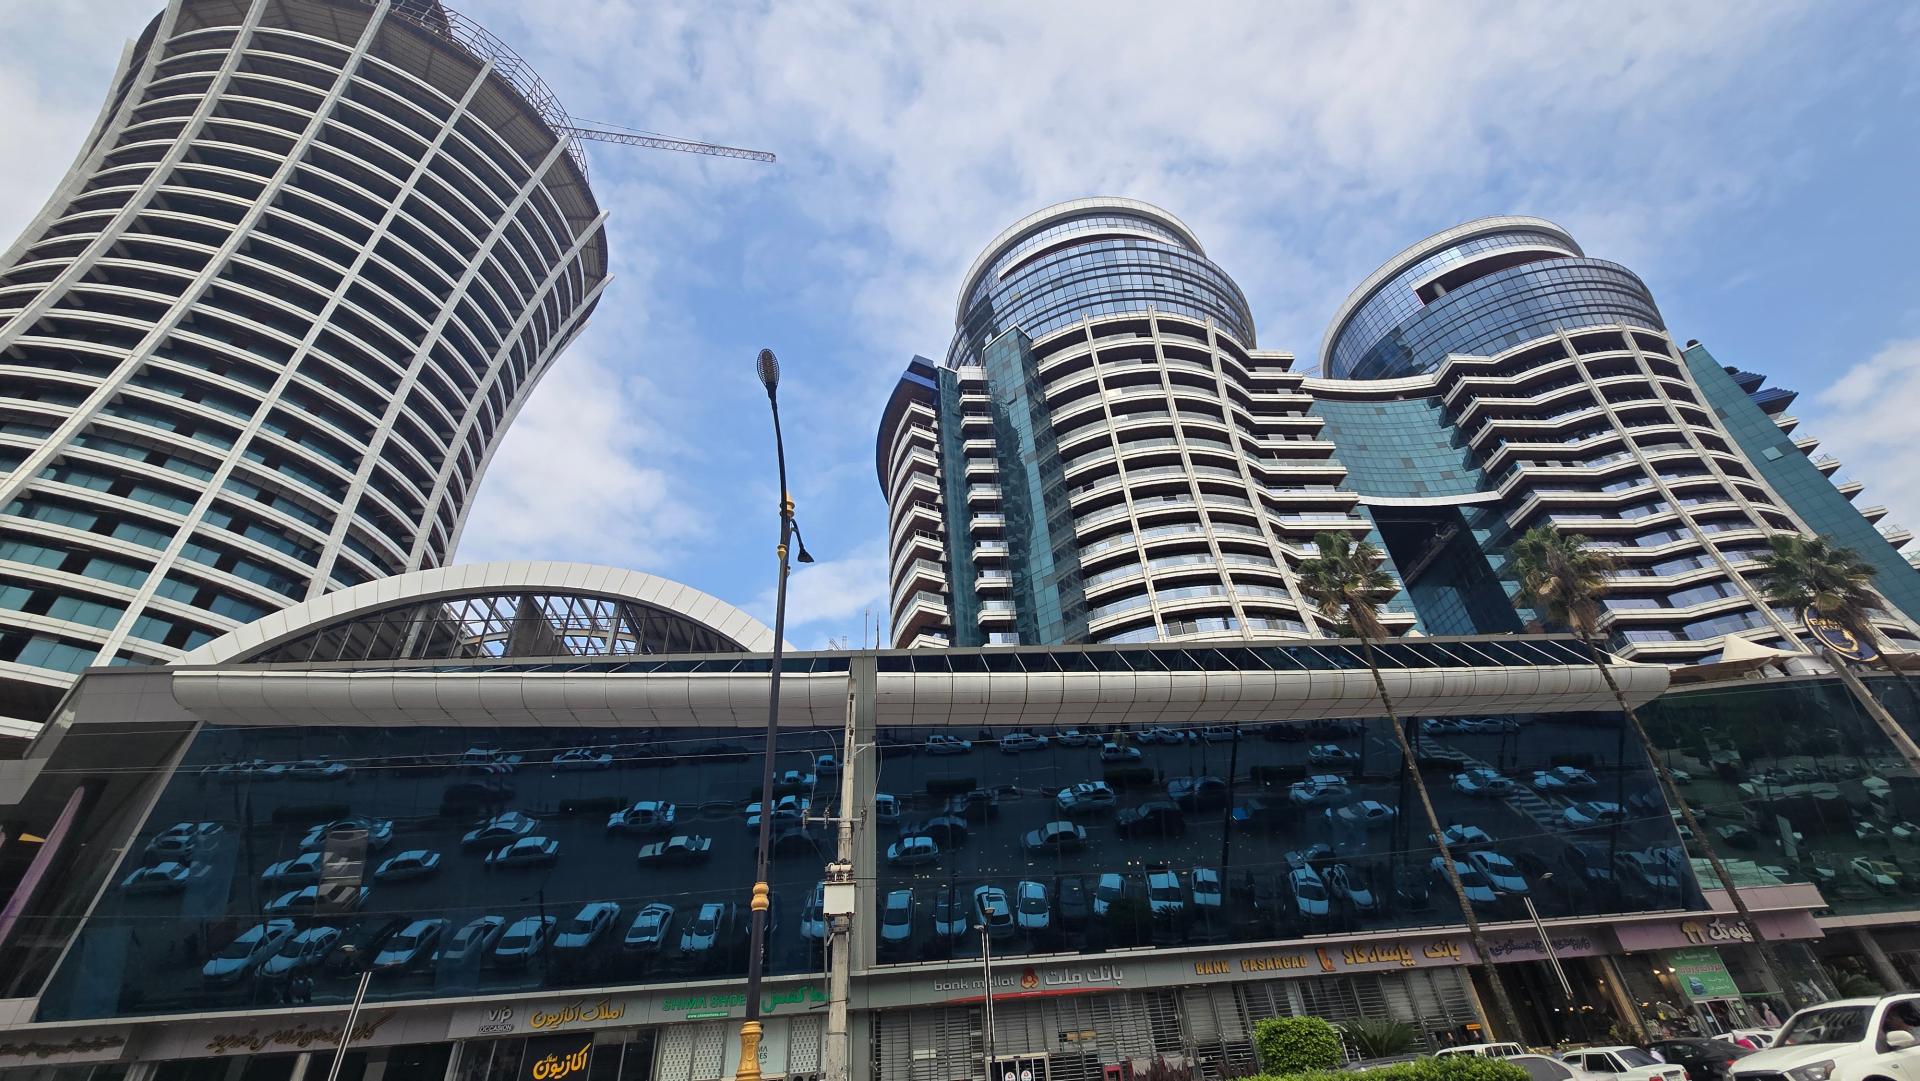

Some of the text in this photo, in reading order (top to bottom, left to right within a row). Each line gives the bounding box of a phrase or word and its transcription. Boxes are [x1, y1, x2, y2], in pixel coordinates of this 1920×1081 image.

[1195, 953, 1309, 975] BANK PASARGAD
[1343, 939, 1462, 967] بانک پاسارگاد
[934, 975, 1015, 991] bank mellat
[1045, 964, 1123, 986] بانک ملت
[663, 992, 747, 1011] SHIMA SHOE
[530, 999, 625, 1029] املاک اکازیون
[479, 1023, 512, 1034] OCCASION
[533, 1042, 591, 1080] اکازیون
